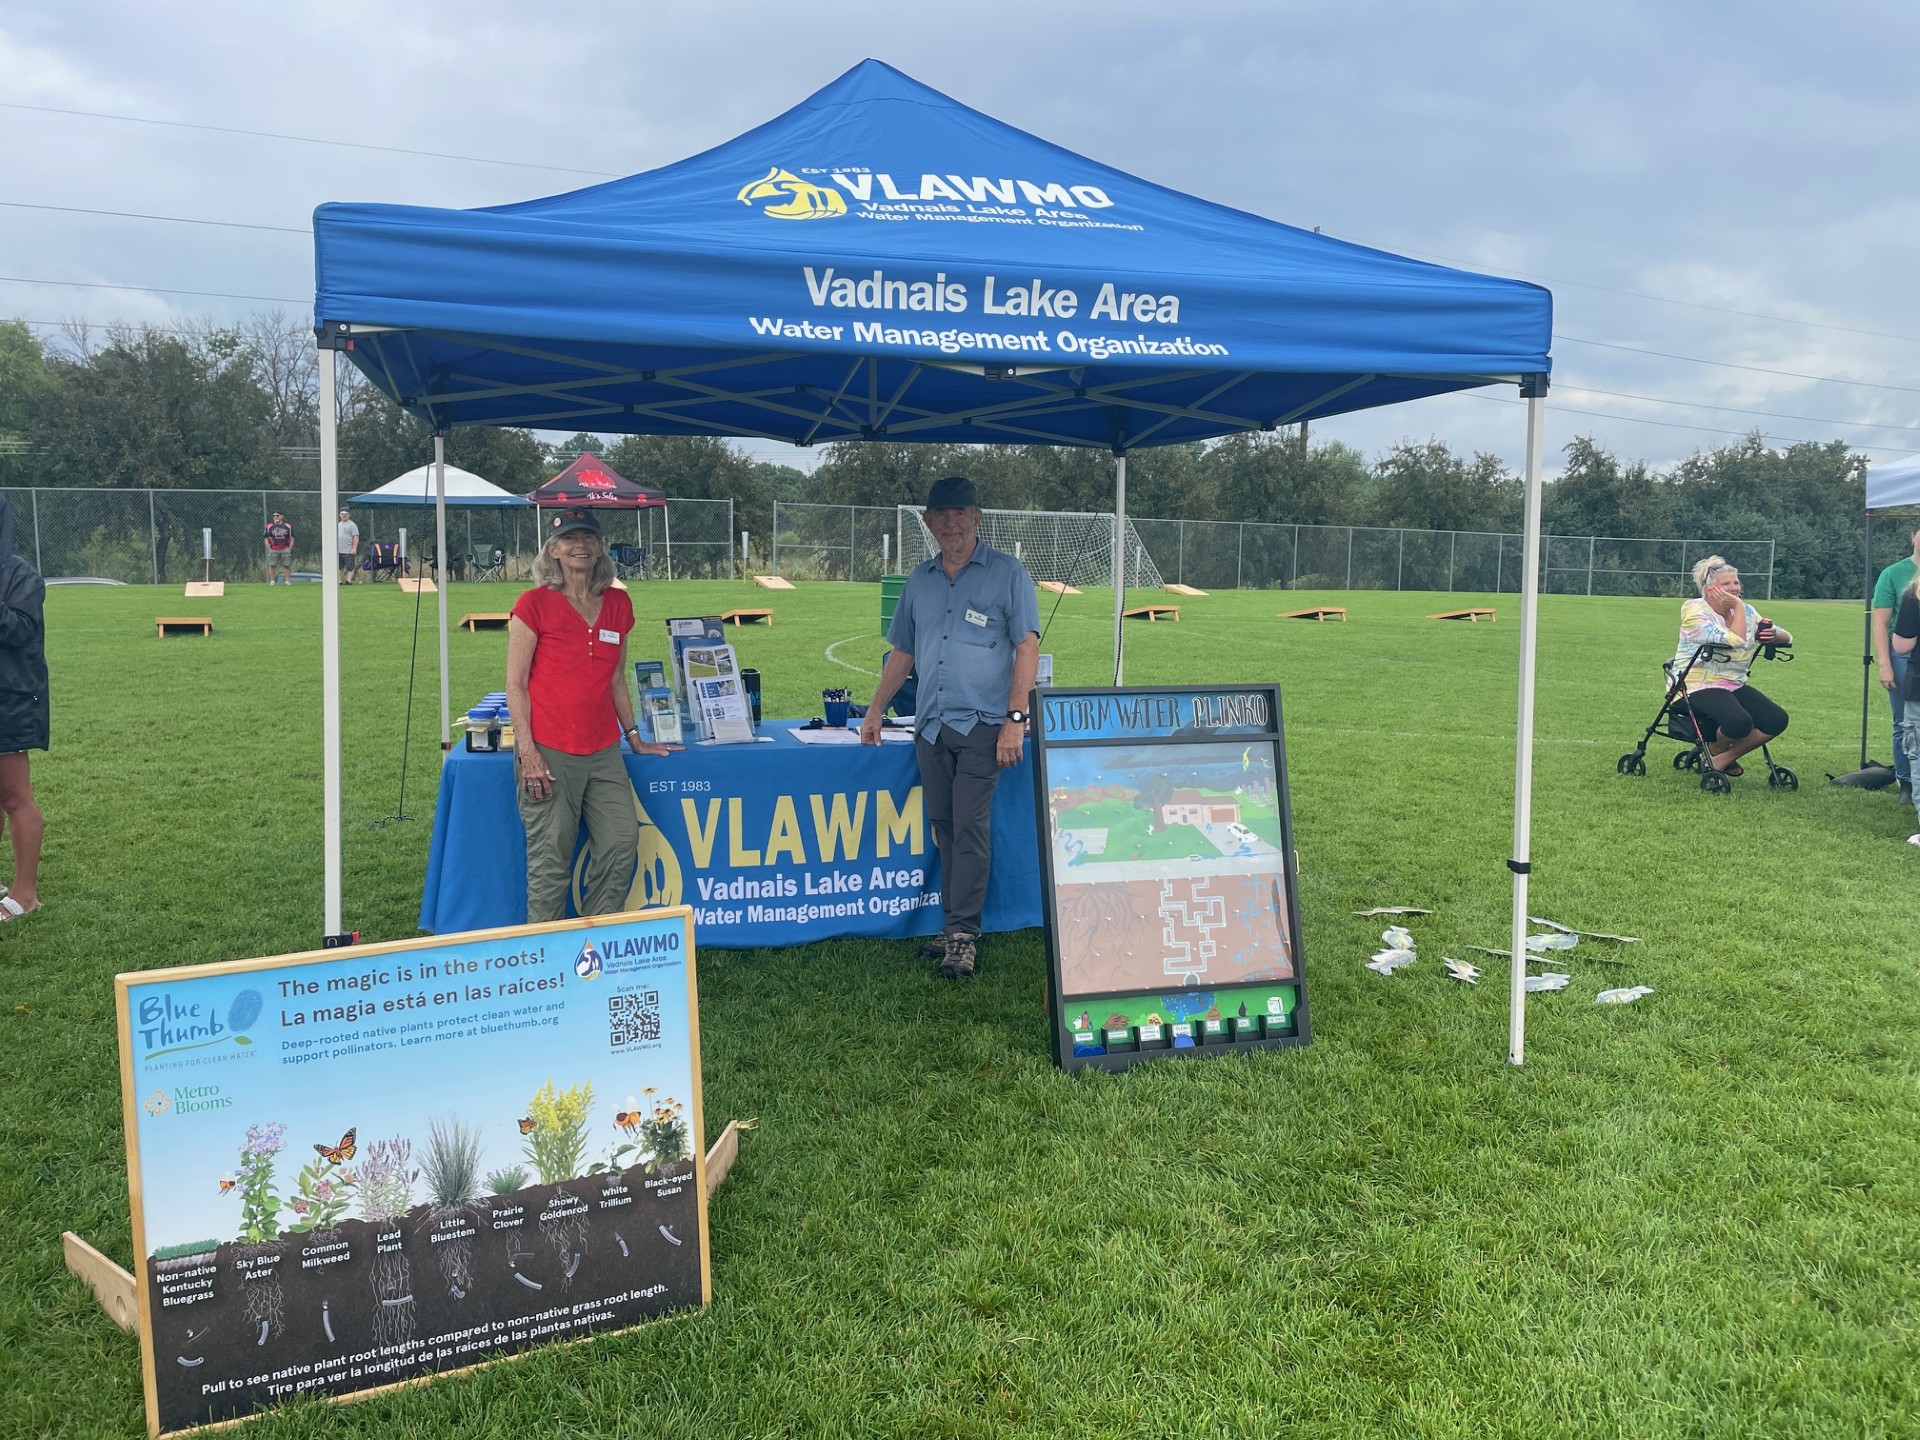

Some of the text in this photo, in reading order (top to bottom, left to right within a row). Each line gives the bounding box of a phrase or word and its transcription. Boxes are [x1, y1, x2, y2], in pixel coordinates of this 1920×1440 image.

[830, 173, 1115, 209] VLAWMO
[861, 202, 1089, 220] Vadnais Lake Area
[855, 211, 1144, 231] Water Management Organization
[803, 266, 1180, 324] Vadnais Lake Area
[748, 316, 1229, 360] Water Management Organization
[1191, 694, 1269, 729] PLINKO
[650, 780, 711, 793] EST 1983
[680, 785, 939, 869] VLAWM
[697, 866, 925, 901] Vadnais Lake Area
[748, 897, 864, 924] Management
[601, 932, 679, 960] VLAWMO
[606, 955, 667, 969] Vadnais Lake Area
[620, 964, 651, 973] Management
[652, 960, 682, 969] Organization
[277, 947, 545, 997] The magic is in the roots!
[616, 985, 634, 993] Scan
[281, 972, 564, 1027] La magia está en las raíces!
[139, 994, 200, 1025] Blue
[138, 1008, 224, 1049] Thumb
[282, 1001, 565, 1051] Deep-rooted native plants protect clean water and
[282, 1016, 559, 1065] support pollinators. Learn more at bluethumb.org
[610, 1043, 662, 1055] www.VLAWMO.org
[144, 1061, 183, 1072] PLANTING
[185, 1058, 201, 1066] FOR
[203, 1055, 228, 1064] CLEAN
[174, 1085, 219, 1101] Metro
[175, 1097, 232, 1115] Blooms
[644, 1172, 693, 1189] Black-eyed
[602, 1185, 629, 1197] White
[657, 1185, 682, 1198] Susan
[548, 1195, 579, 1208] Showy
[599, 1196, 632, 1210] Trillium
[492, 1205, 524, 1219] Prairie
[539, 1204, 589, 1222] Goldenrod
[440, 1217, 466, 1230] Little
[492, 1217, 525, 1230] Clover
[377, 1229, 402, 1243] Lead
[430, 1227, 476, 1243] Bluestem
[302, 1241, 349, 1257] Common
[377, 1241, 403, 1254] Plant
[236, 1254, 281, 1270] Sky Blue
[302, 1251, 350, 1269] Milkweed
[156, 1265, 217, 1283] Non-native
[244, 1267, 273, 1281] Aster
[162, 1277, 213, 1295] Kentucky
[162, 1290, 215, 1307] Bluegrass
[201, 1283, 669, 1395] Pull to see native plant root lengths compared to non-native grass root length.
[267, 1310, 616, 1396] Tire para ver la longitud de las raíces de las plantas nativas.
